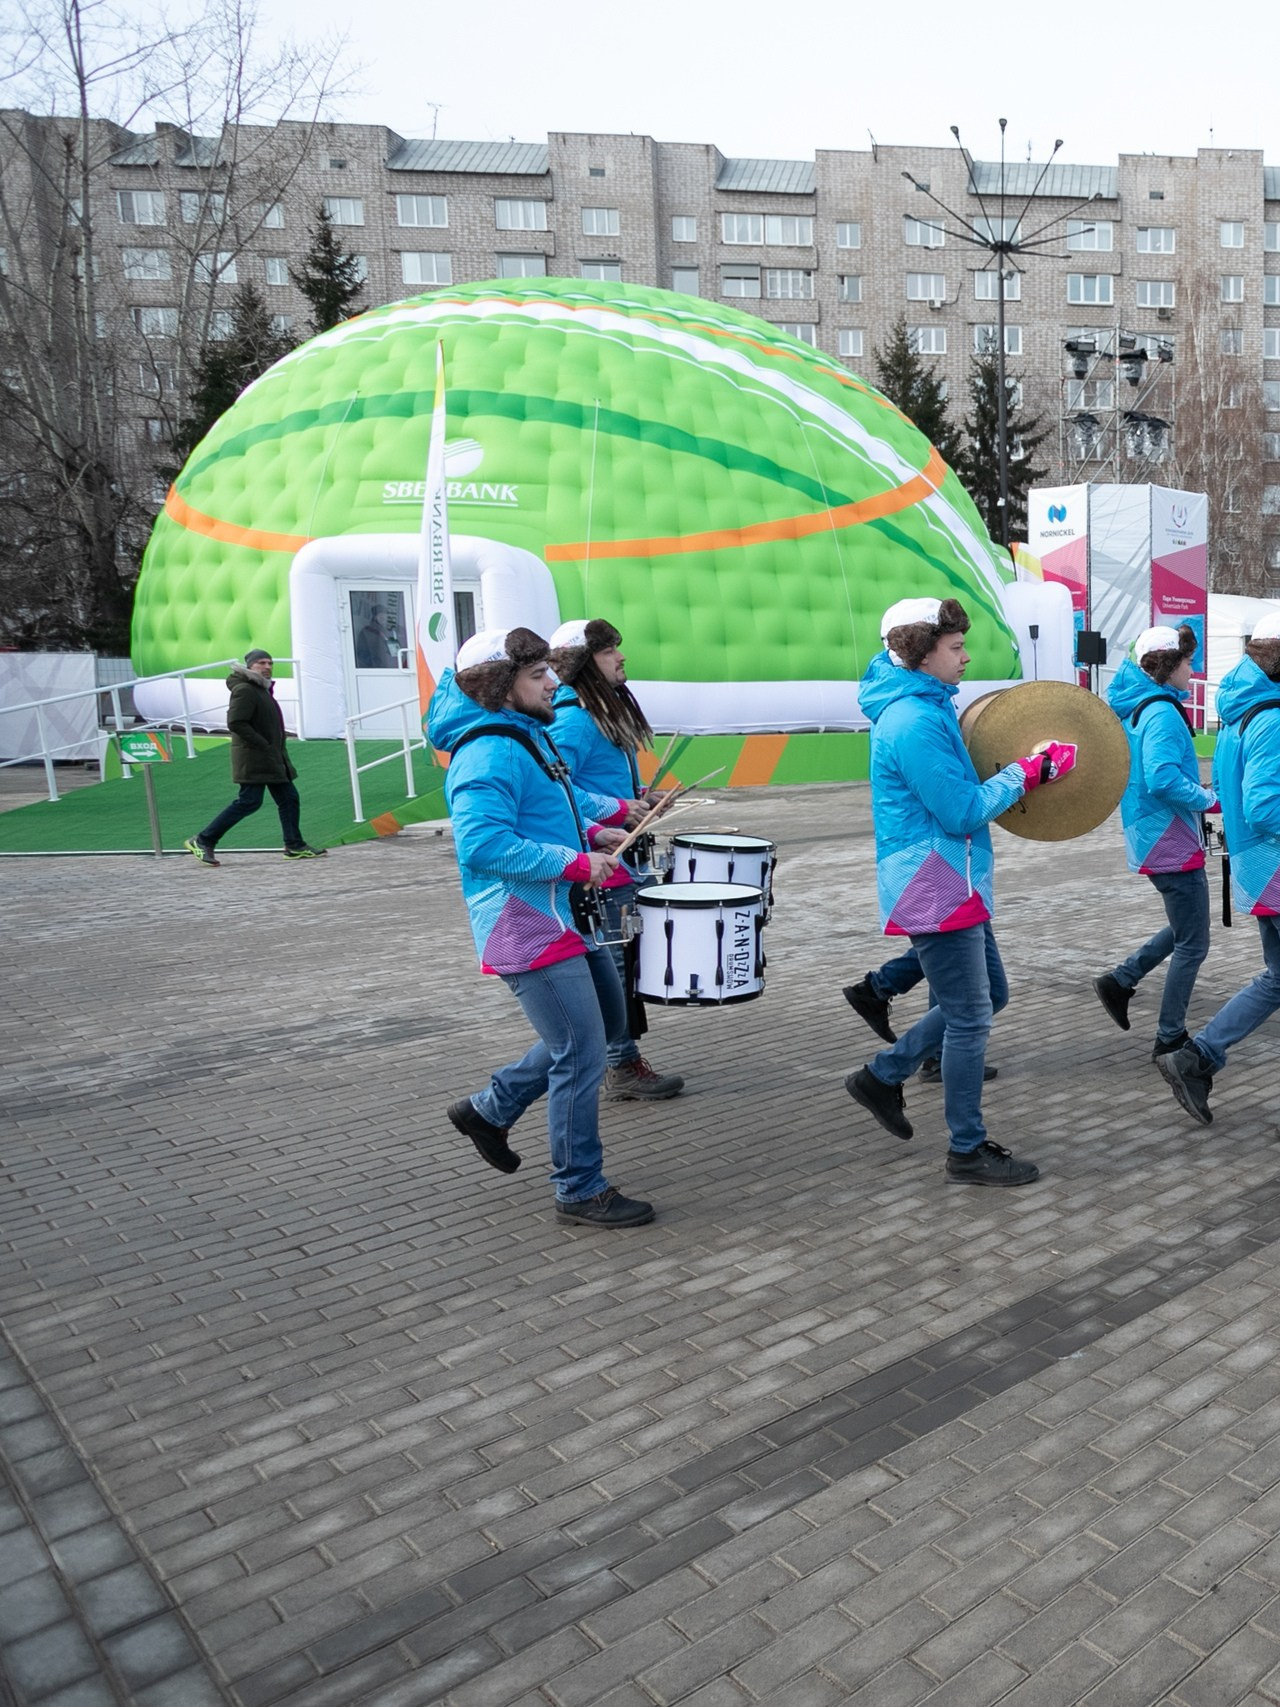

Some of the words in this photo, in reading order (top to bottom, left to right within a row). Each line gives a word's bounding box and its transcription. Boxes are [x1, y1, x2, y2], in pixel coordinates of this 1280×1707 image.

[382, 481, 518, 501] SBEBANK
[1040, 529, 1075, 538] NORNICKEL
[129, 742, 158, 750] ВХОД
